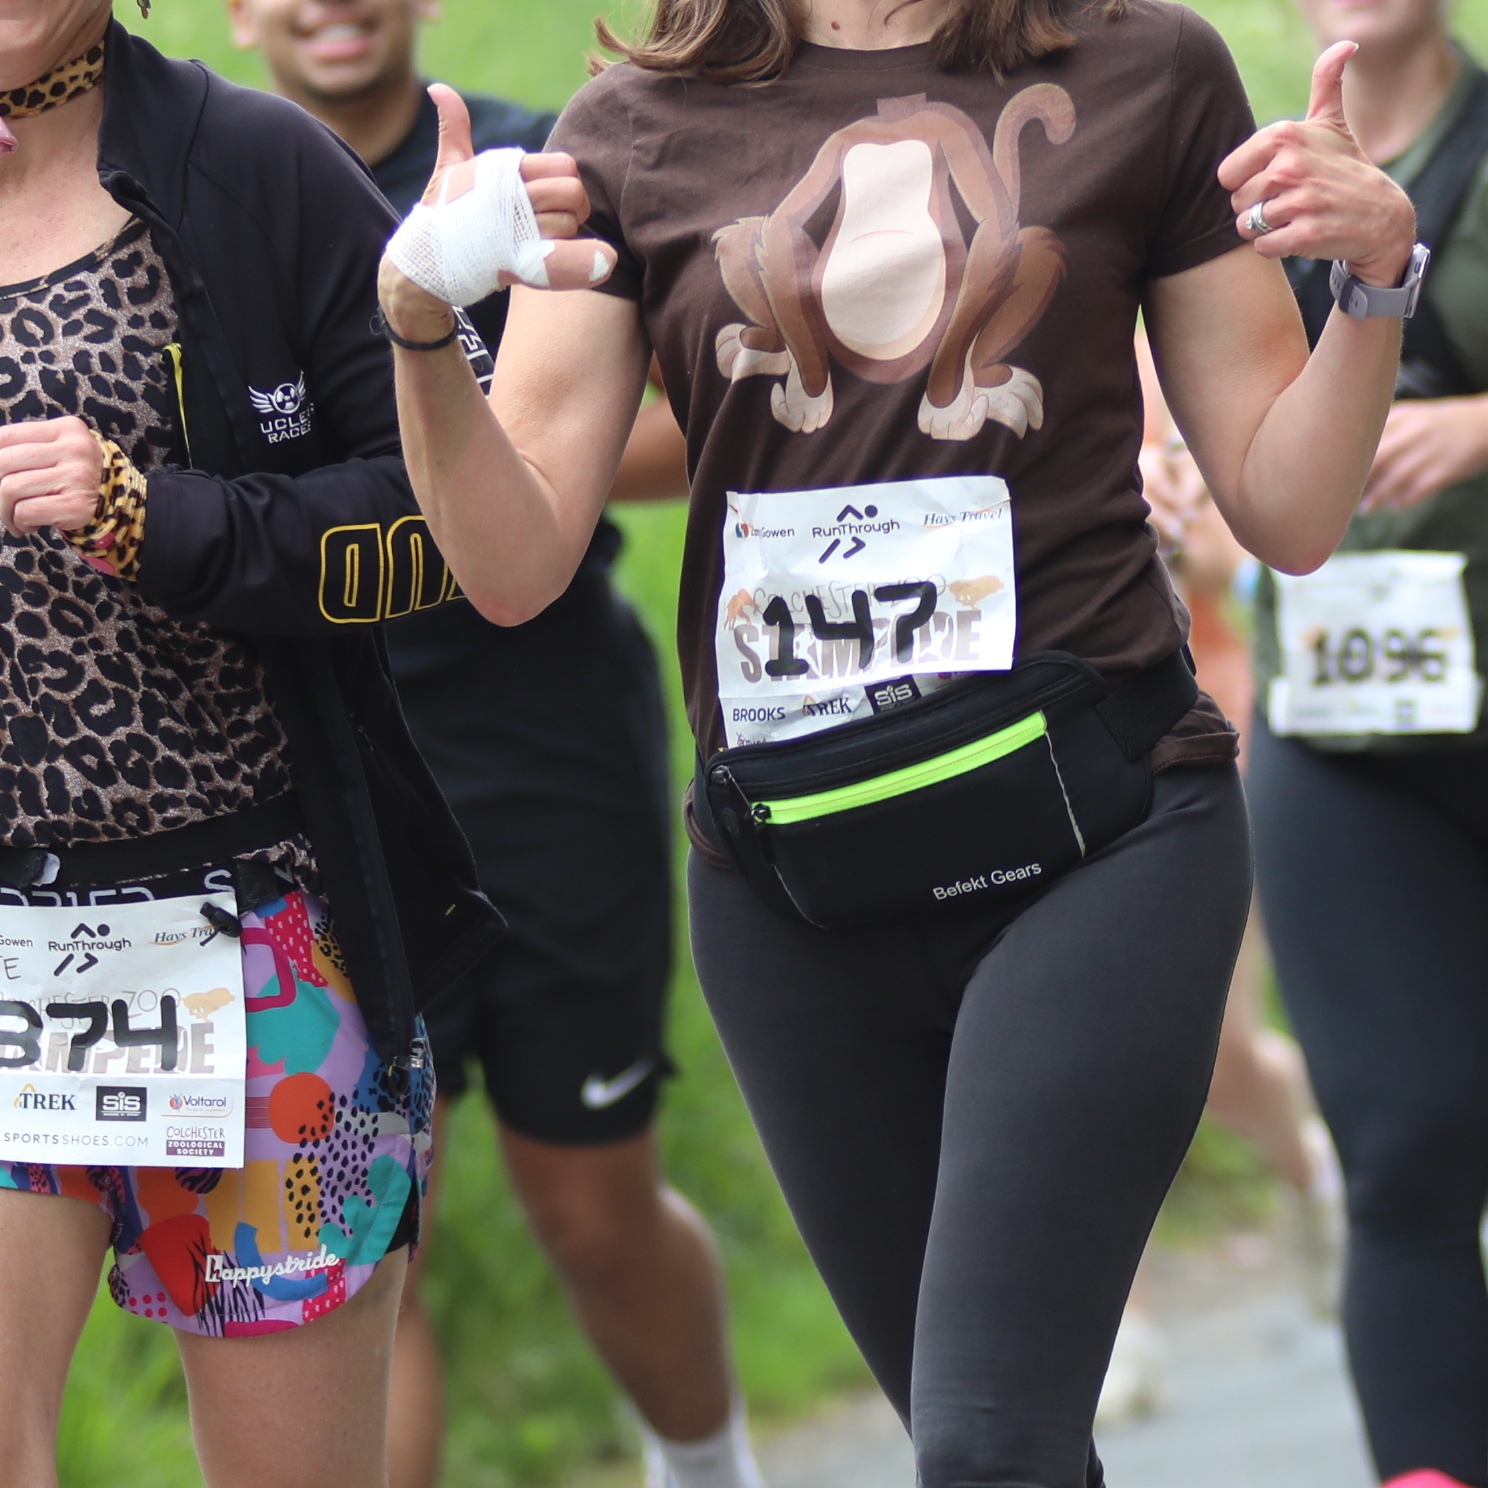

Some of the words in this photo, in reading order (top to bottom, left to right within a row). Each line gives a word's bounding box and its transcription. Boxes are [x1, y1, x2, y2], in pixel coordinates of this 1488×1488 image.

[923, 513, 956, 526] Hays
[812, 519, 900, 538] RunThrough
[763, 581, 937, 677] 147
[732, 706, 787, 722] BROOKS
[803, 697, 853, 716] TREK
[932, 875, 988, 900] Befekt
[991, 863, 1042, 885] Gears
[154, 932, 187, 944] Hays
[190, 927, 215, 938] Tra
[48, 937, 132, 952] RunThrough
[19, 1092, 78, 1111] TREK
[183, 1095, 226, 1107] Voltarol
[4, 1133, 149, 1147] SPORTSSHOES.COM
[166, 1126, 225, 1139] COLCHESTER
[168, 1141, 223, 1149] ZOOLOGICAL
[177, 1148, 215, 1156] SOCIETY
